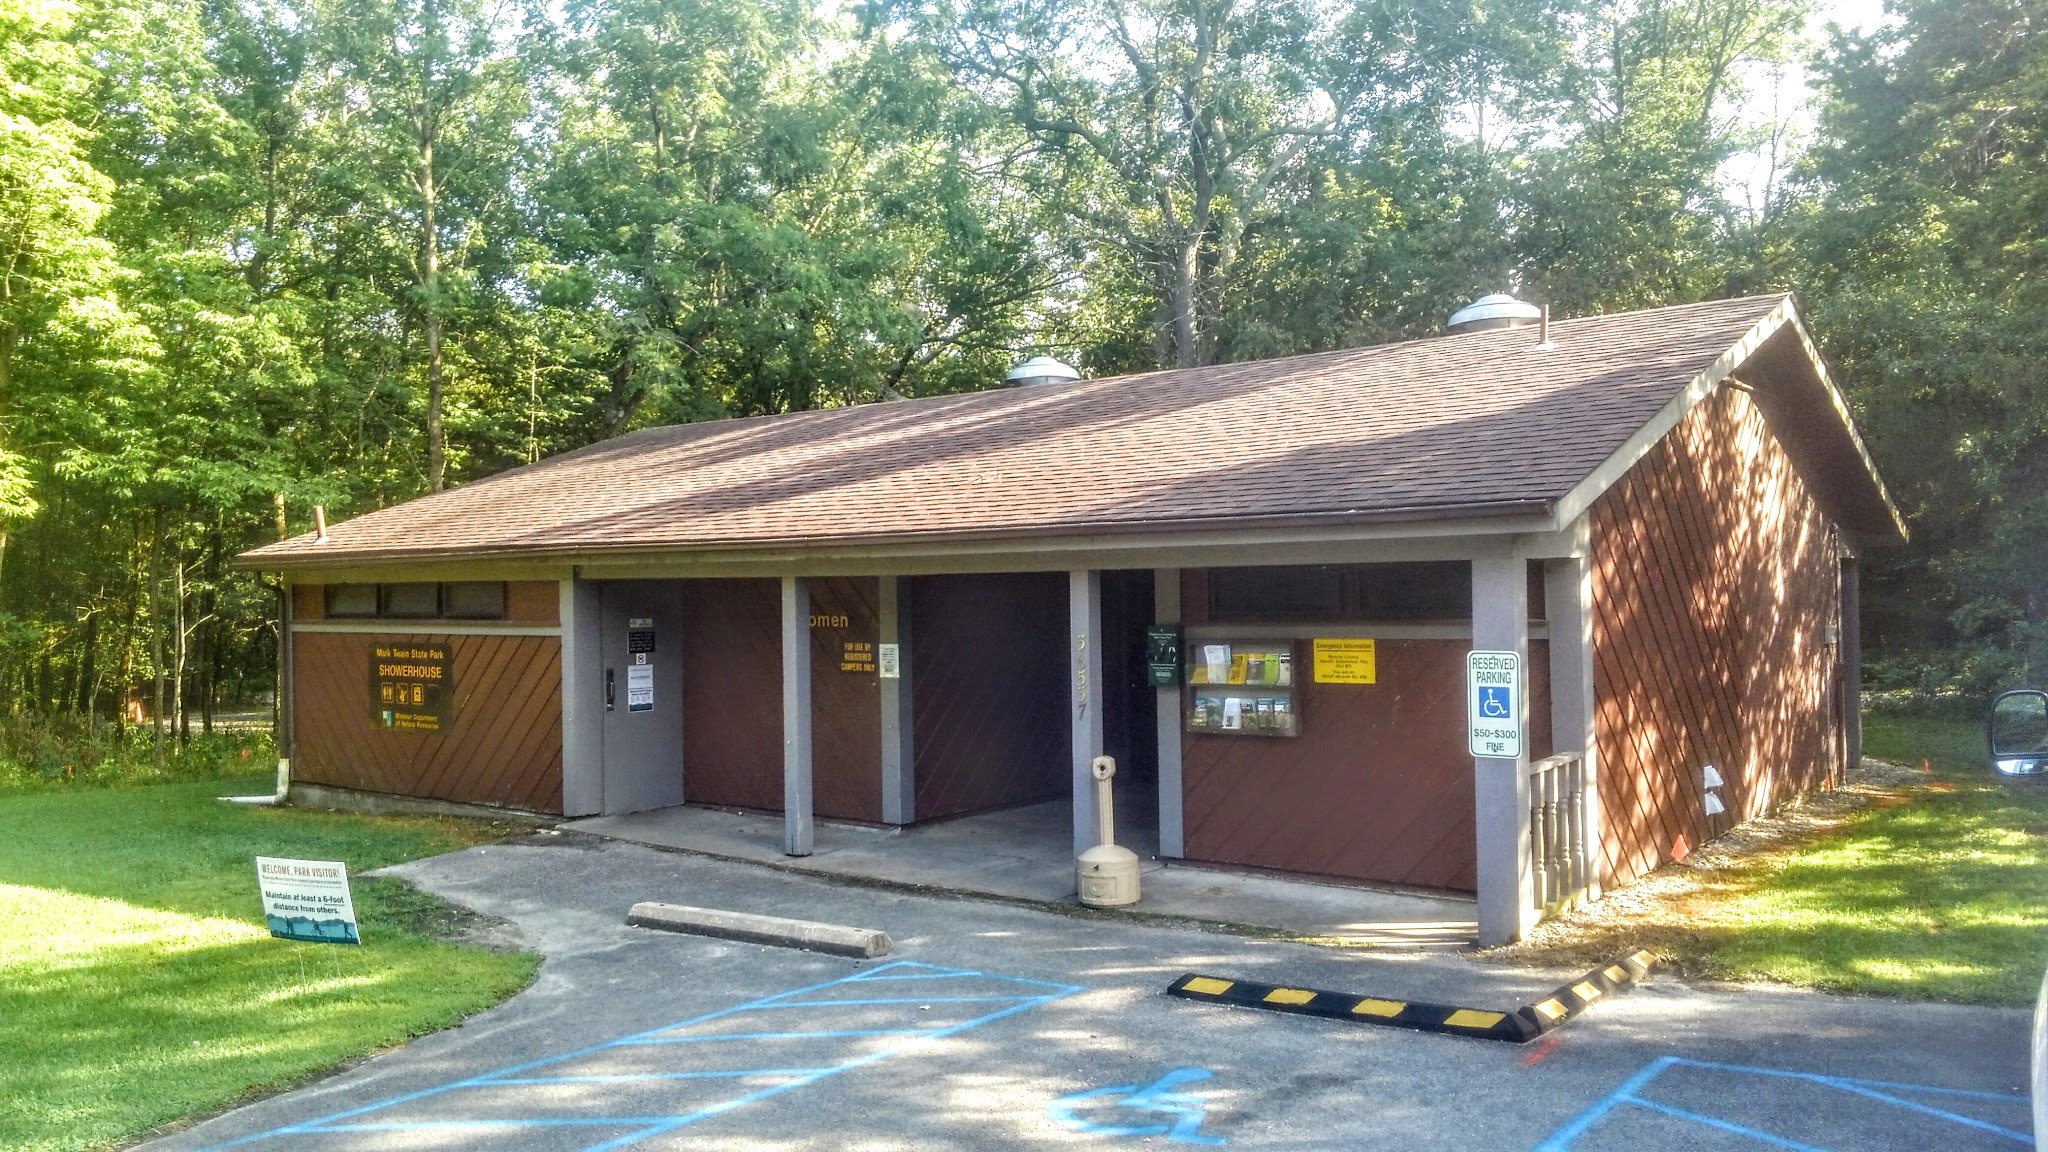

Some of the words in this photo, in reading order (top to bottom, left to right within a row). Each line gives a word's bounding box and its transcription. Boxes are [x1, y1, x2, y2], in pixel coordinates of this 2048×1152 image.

[808, 615, 848, 627] omen
[864, 643, 871, 651] BY
[376, 648, 391, 657] Mark
[393, 649, 409, 658] Twain
[411, 649, 428, 659] State
[429, 650, 444, 659] Park
[845, 653, 871, 661] REGISTERED
[841, 663, 862, 671] CAMPERS
[1472, 657, 1515, 670] RESERVED
[379, 664, 442, 679] SHOWERHOUSE
[1476, 671, 1512, 684] PARKING
[413, 714, 438, 722] Department
[417, 722, 439, 730] Resources
[1473, 728, 1517, 739] $50-$300
[1486, 742, 1505, 751] FINE
[261, 864, 294, 876] WELCOME,
[294, 866, 310, 876] PARK
[312, 868, 340, 878] VISITOR!
[265, 891, 292, 900] Maintain
[301, 894, 316, 903] least
[323, 895, 345, 904] 6-foot
[273, 903, 299, 911] distance
[299, 904, 316, 913] from
[316, 906, 340, 914] others.
